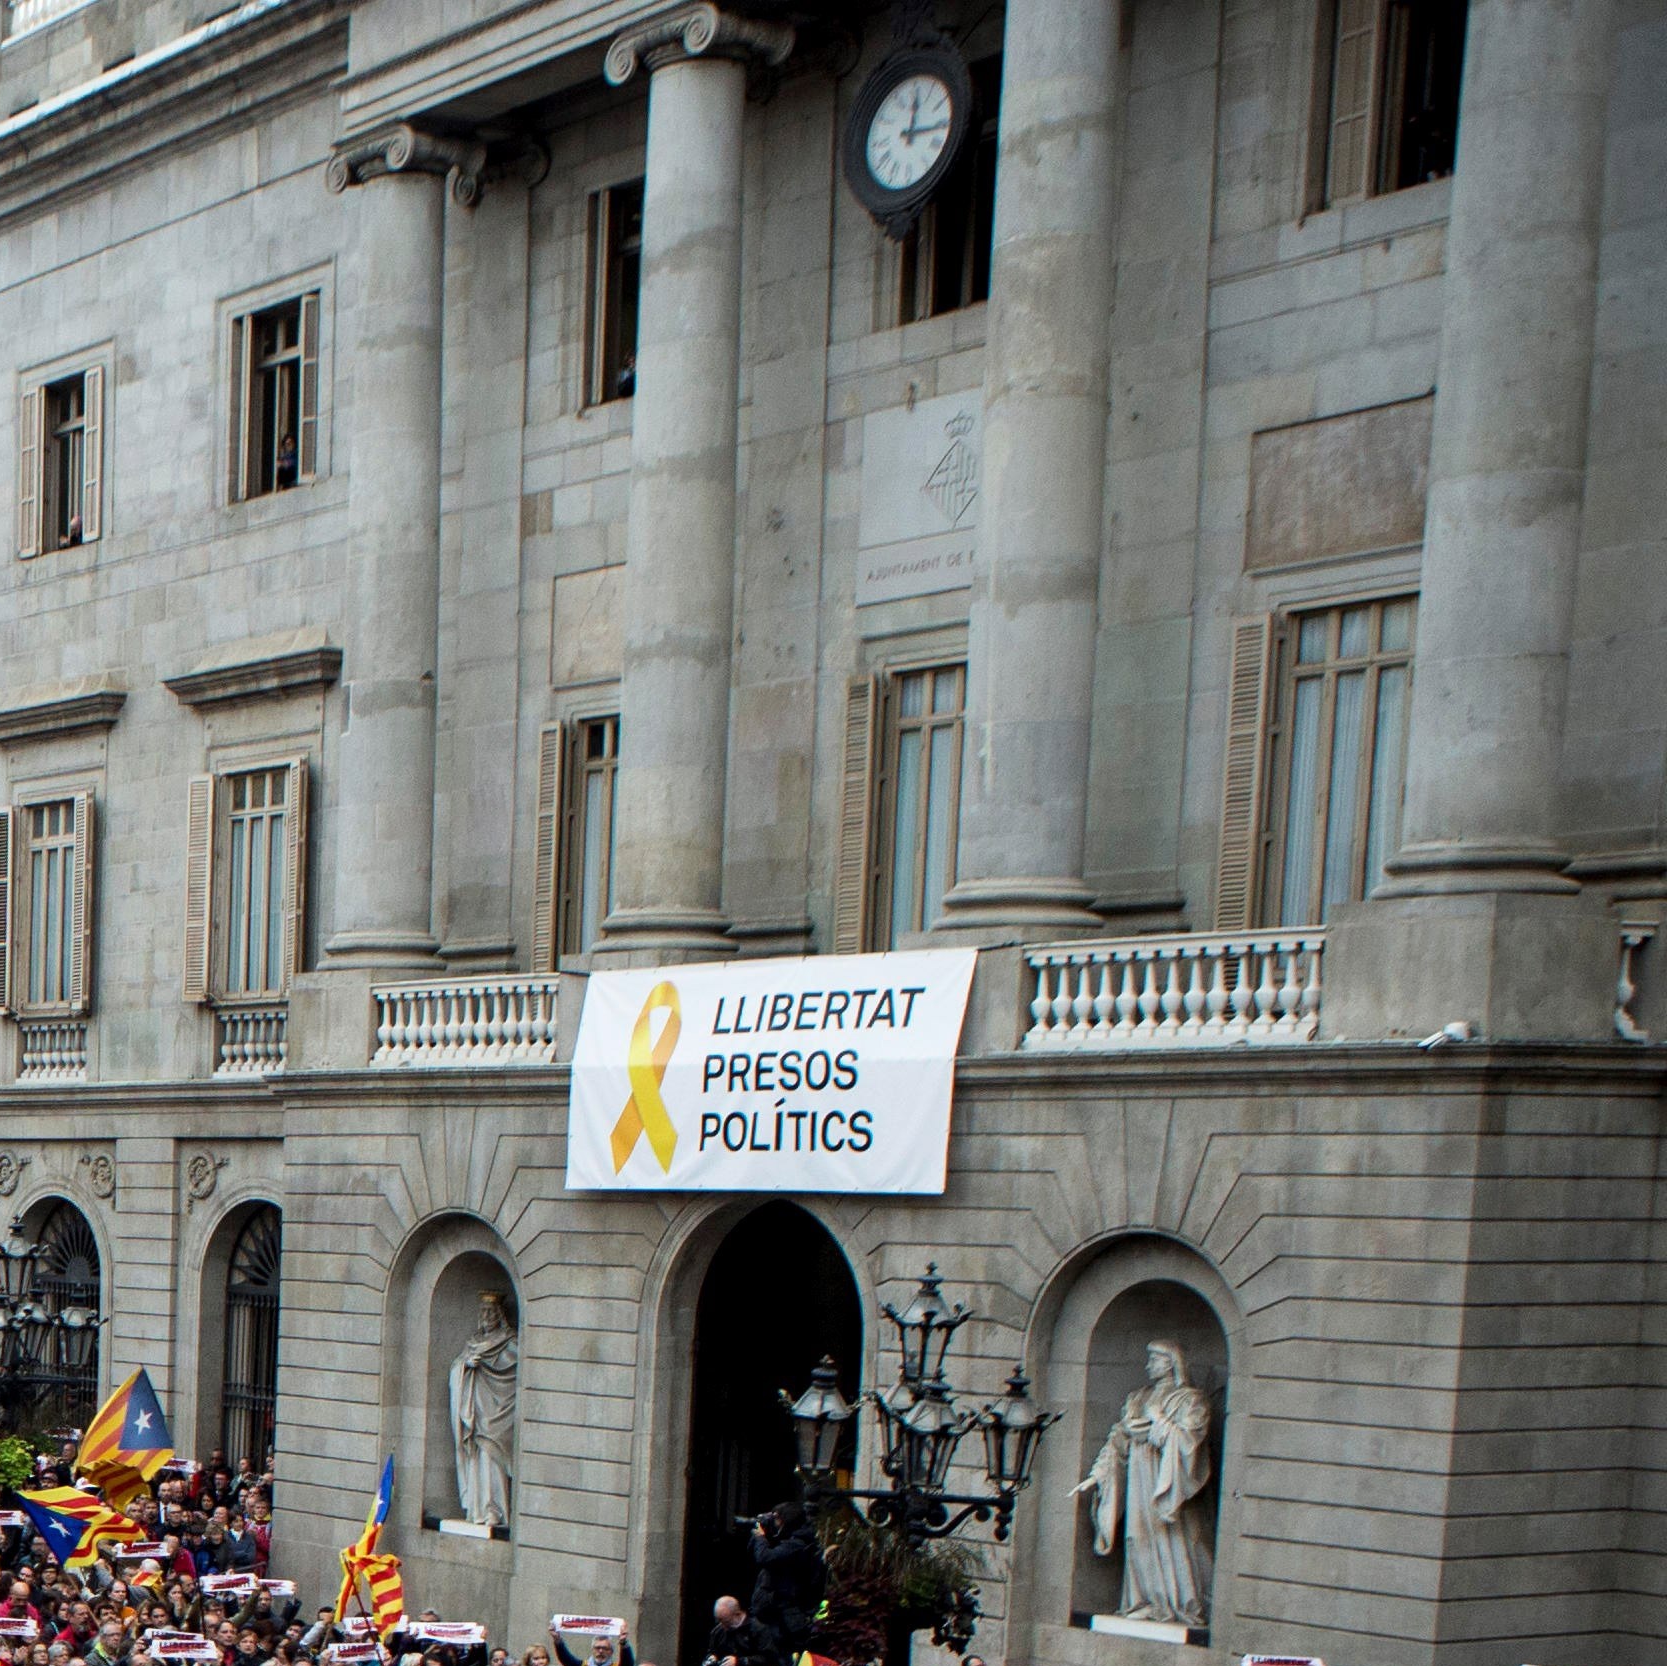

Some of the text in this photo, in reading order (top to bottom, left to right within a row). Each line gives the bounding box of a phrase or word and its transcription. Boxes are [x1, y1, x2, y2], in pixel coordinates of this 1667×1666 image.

[712, 987, 926, 1035] LLIBERTAT
[702, 1048, 859, 1093] PRESOS
[699, 1097, 874, 1152] POLÍTICS
